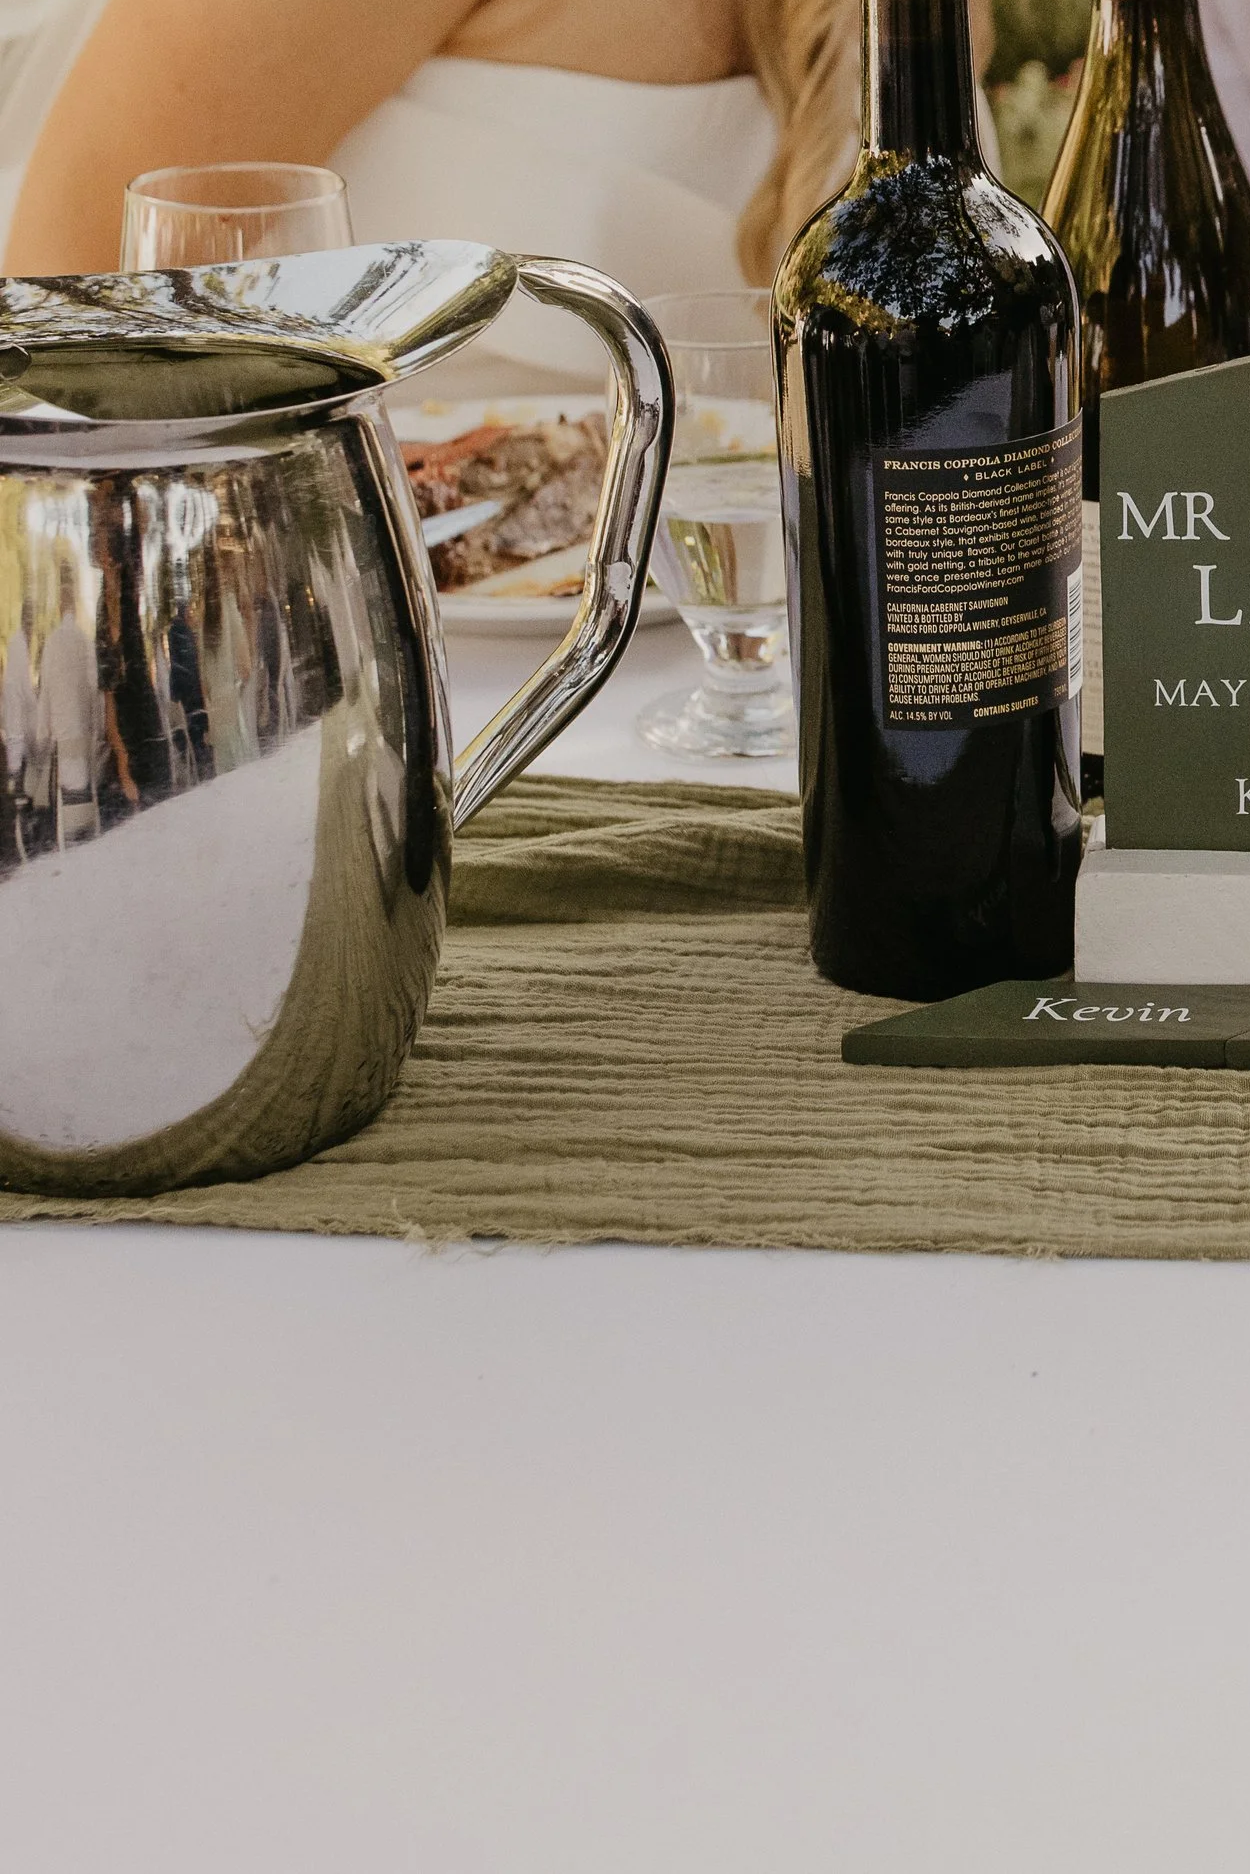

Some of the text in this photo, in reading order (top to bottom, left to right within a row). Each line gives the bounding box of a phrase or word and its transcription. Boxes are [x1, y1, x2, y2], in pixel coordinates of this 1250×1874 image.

[884, 461, 941, 470] FRANCIS
[944, 456, 1001, 469] COPPOLA
[1004, 443, 1051, 463] DIAMOND
[975, 460, 1047, 481] BLACK LABEL
[884, 491, 916, 502] Francis
[918, 492, 960, 502] Coppola
[962, 486, 1002, 500] Diamond
[1004, 479, 1041, 494] Collection
[884, 503, 922, 515] offering.
[924, 504, 936, 513] As
[938, 503, 948, 512] its
[950, 495, 1011, 512] British-derived
[1012, 493, 1034, 504] name
[885, 516, 910, 524] same
[913, 515, 933, 526] style
[936, 516, 947, 524] as
[949, 511, 998, 523] Bordeaux's
[999, 506, 1020, 517] finest
[1116, 491, 1231, 541] MR
[885, 527, 892, 535] a
[895, 526, 940, 536] Cabernet
[942, 518, 1018, 535] Sauvignon-based
[885, 537, 930, 548] bordeaux
[958, 536, 976, 545] that
[978, 532, 1010, 544] exhibits
[1012, 521, 1051, 538] exceptional
[886, 550, 905, 559] with
[908, 550, 928, 560] truly
[931, 550, 963, 560] unique
[967, 546, 997, 556] flavors.
[1000, 542, 1016, 552] Our
[1018, 536, 1040, 548] Claret
[886, 560, 905, 570] with
[907, 561, 929, 573] gold
[969, 559, 976, 568] a
[978, 554, 1005, 566] tribute
[1007, 553, 1015, 562] to
[1018, 550, 1030, 560] the
[1031, 546, 1046, 557] way
[886, 573, 910, 582] were
[914, 573, 940, 582] once
[944, 569, 994, 583] presented.
[997, 565, 1021, 576] Learn
[1024, 558, 1042, 570] more
[886, 575, 1025, 594] FrancisFordCoppolaWinery.com
[887, 597, 1009, 613] CALIFORNIA CABERNET SAUVIGNON
[887, 613, 964, 624] VINTED & BOTTLED BY
[887, 624, 918, 634] FRANCIS
[919, 624, 938, 634] FORD
[939, 622, 972, 634] COPPOLA
[1039, 607, 1047, 616] CA
[887, 642, 942, 653] GOVERNMENT
[943, 640, 983, 653] WARNING:
[984, 639, 993, 650] (1)
[994, 631, 1030, 647] ACCORDING
[1030, 628, 1038, 638] TO
[922, 653, 952, 664] WOMEN
[952, 651, 980, 663] SHOULD
[980, 649, 995, 660] NOT
[995, 645, 1015, 657] DRINK
[1015, 638, 1044, 654] ALCOHOLIC
[888, 663, 916, 674] DURING
[916, 663, 960, 674] PREGNANCY
[961, 659, 992, 672] BECAUSE
[992, 658, 1001, 668] OF
[1001, 655, 1014, 666] THE
[1013, 652, 1027, 664] RISK
[1027, 650, 1035, 660] OF
[888, 674, 898, 684] (2)
[898, 673, 952, 684] CONSUMPTION
[953, 673, 963, 683] OF
[964, 669, 1002, 682] ALCOHOLIC
[1002, 660, 1036, 676] BEVERAGES
[888, 684, 915, 695] ABILITY
[917, 684, 927, 695] TO
[928, 684, 950, 695] DRIVE
[951, 684, 957, 694] A
[958, 682, 973, 693] CAR
[974, 682, 984, 691] OR
[985, 675, 1014, 690] OPERATE
[1153, 678, 1248, 708] MAY
[889, 692, 981, 705] CAUSE HEALTH PROBLEMS.
[973, 695, 1039, 718] CONTAINS SULFITES
[906, 711, 927, 721] 14.5%
[928, 711, 938, 721] BY
[938, 711, 953, 721] VOL
[1022, 996, 1192, 1024] Kevin
